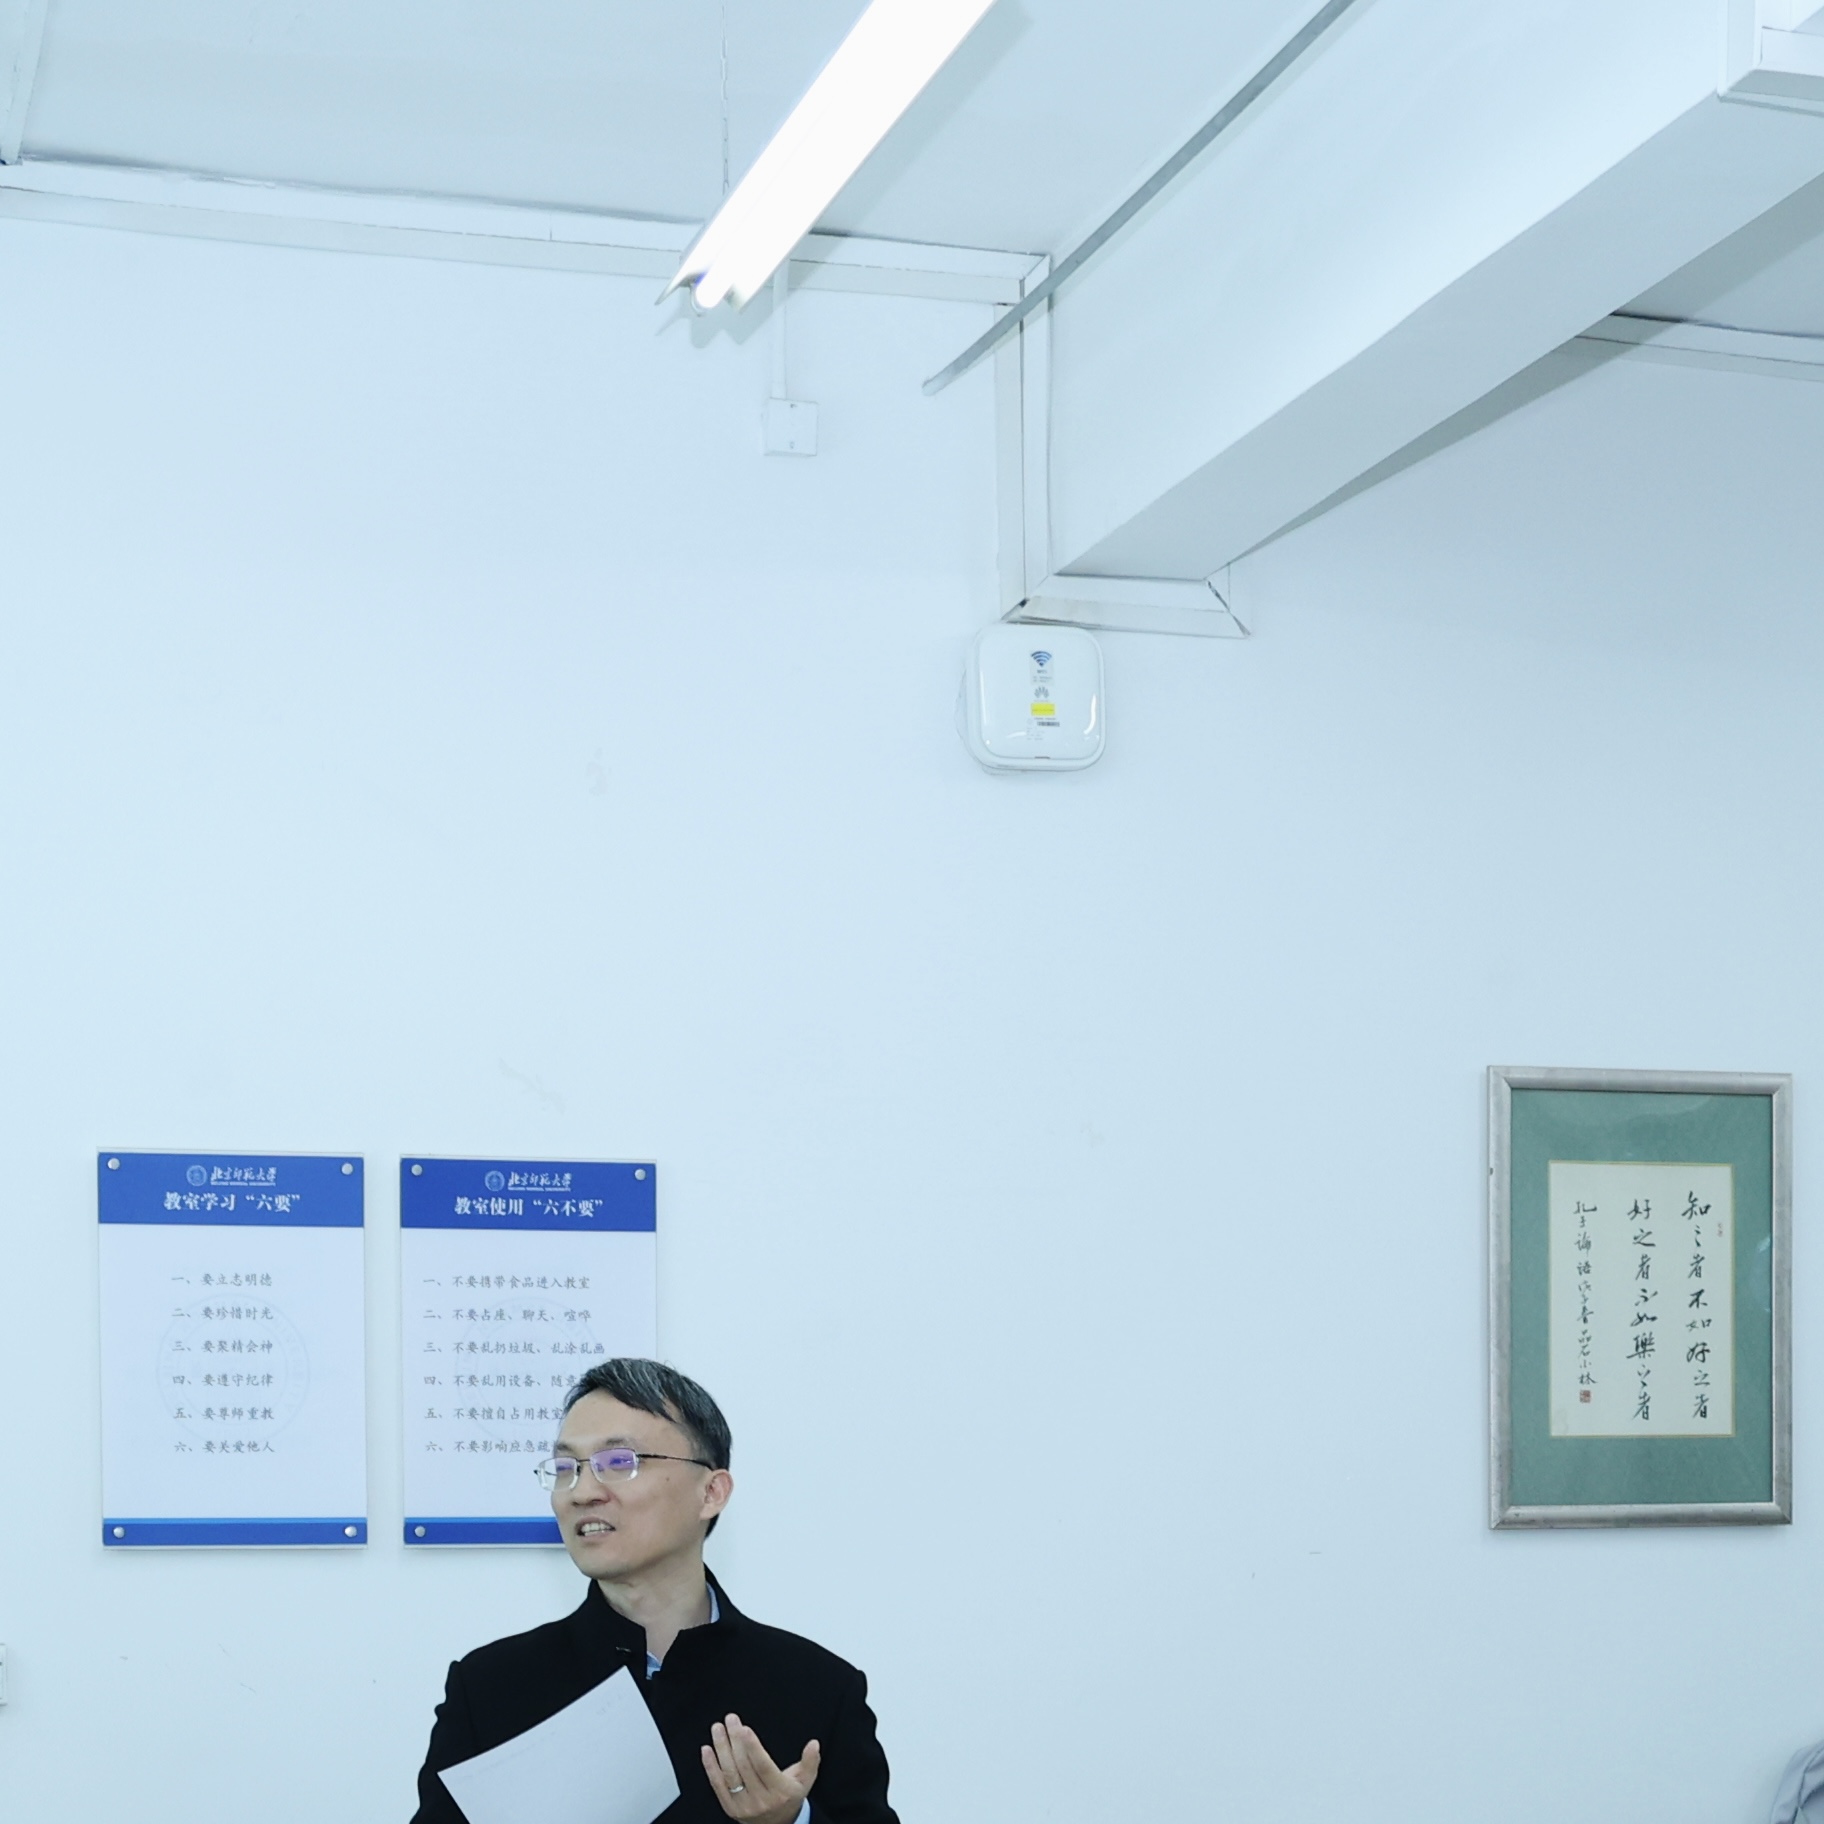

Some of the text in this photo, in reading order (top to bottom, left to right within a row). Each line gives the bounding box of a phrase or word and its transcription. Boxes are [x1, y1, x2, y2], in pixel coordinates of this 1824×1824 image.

[425, 1439, 556, 1455] 六、不要影响应急疏
